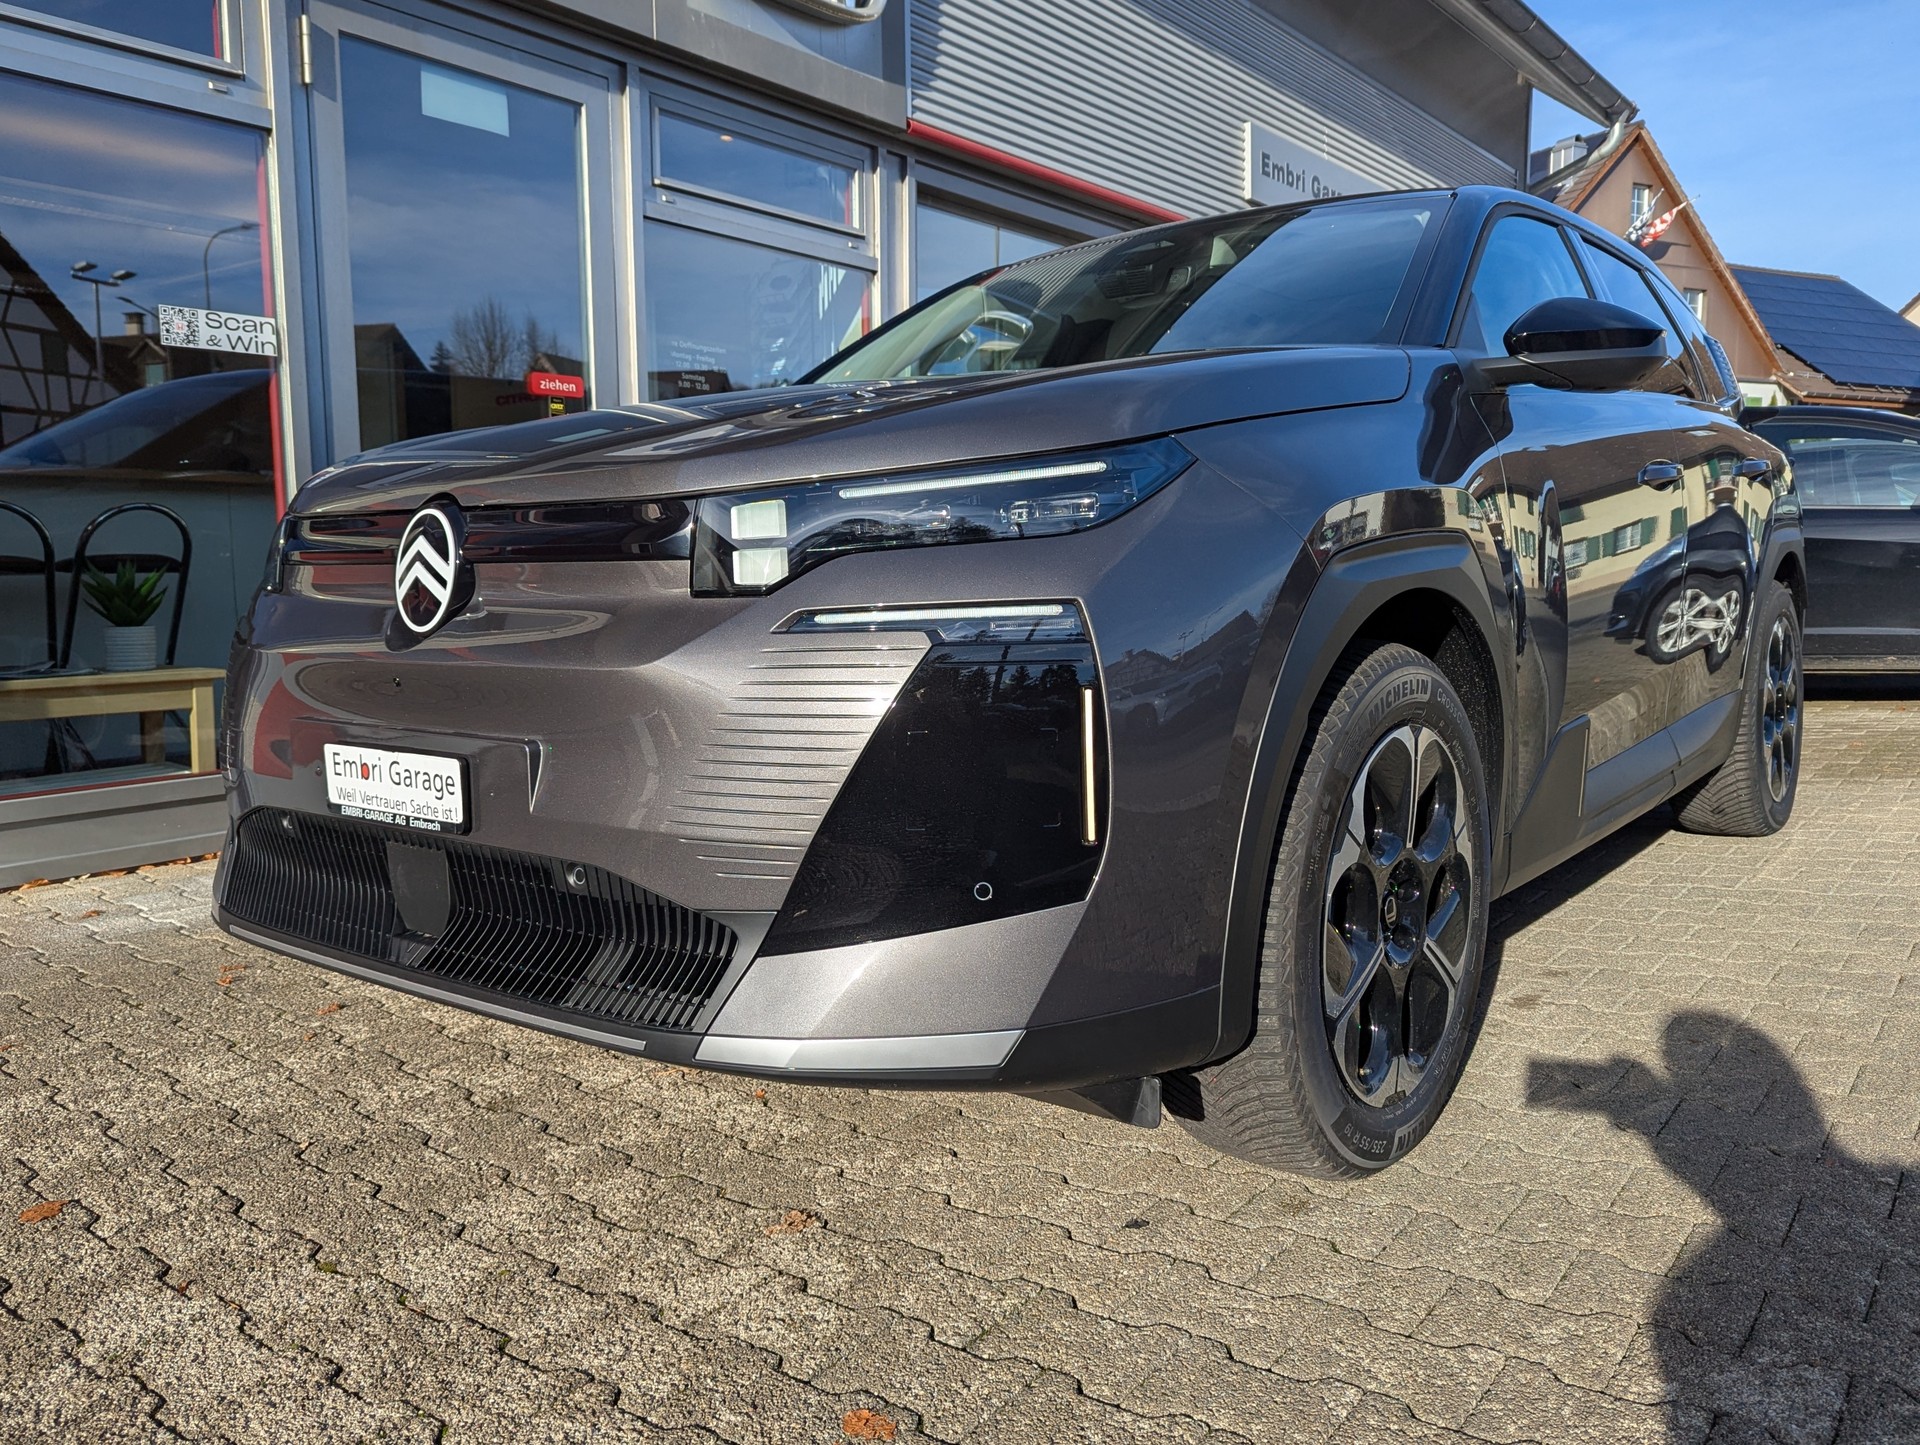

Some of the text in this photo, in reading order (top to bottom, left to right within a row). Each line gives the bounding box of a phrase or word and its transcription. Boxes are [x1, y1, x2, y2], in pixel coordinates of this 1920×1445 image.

[1261, 151, 1342, 198] Embri Gar
[205, 312, 276, 336] Scan
[206, 334, 277, 355] & Win
[540, 379, 577, 392] ziehen
[1368, 678, 1429, 726] MICHELIN
[332, 752, 455, 800] Embri Garage
[336, 786, 357, 803] Weil
[359, 790, 408, 812] Vertrauen
[410, 800, 439, 818] Sache
[341, 805, 441, 832] EMBRI-GARAGE AG Embrach
[1344, 1123, 1387, 1154] 235/55 R 19
